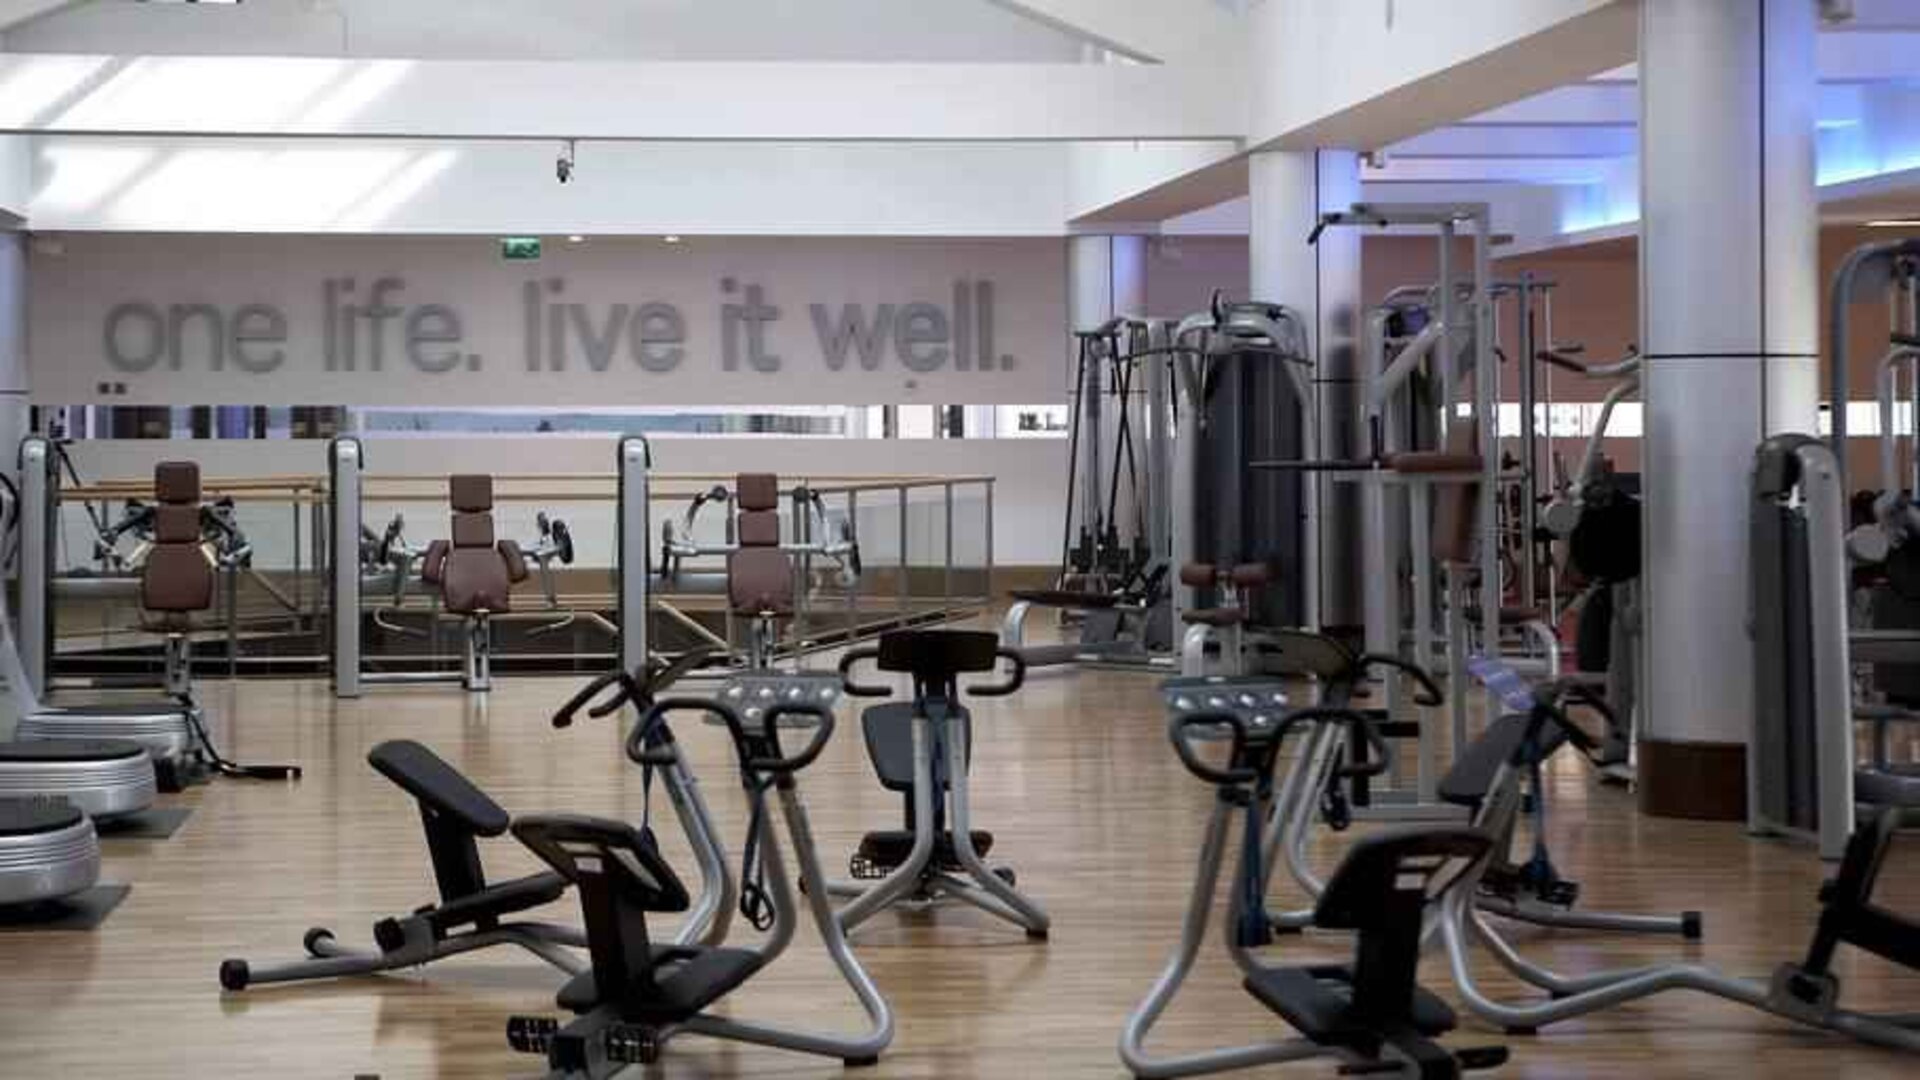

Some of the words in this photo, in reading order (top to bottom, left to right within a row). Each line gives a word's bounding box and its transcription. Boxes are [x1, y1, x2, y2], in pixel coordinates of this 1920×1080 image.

[102, 300, 287, 374] one
[322, 277, 482, 373] life.
[522, 277, 686, 373] live
[719, 276, 781, 373] it
[811, 277, 1016, 373] well.
